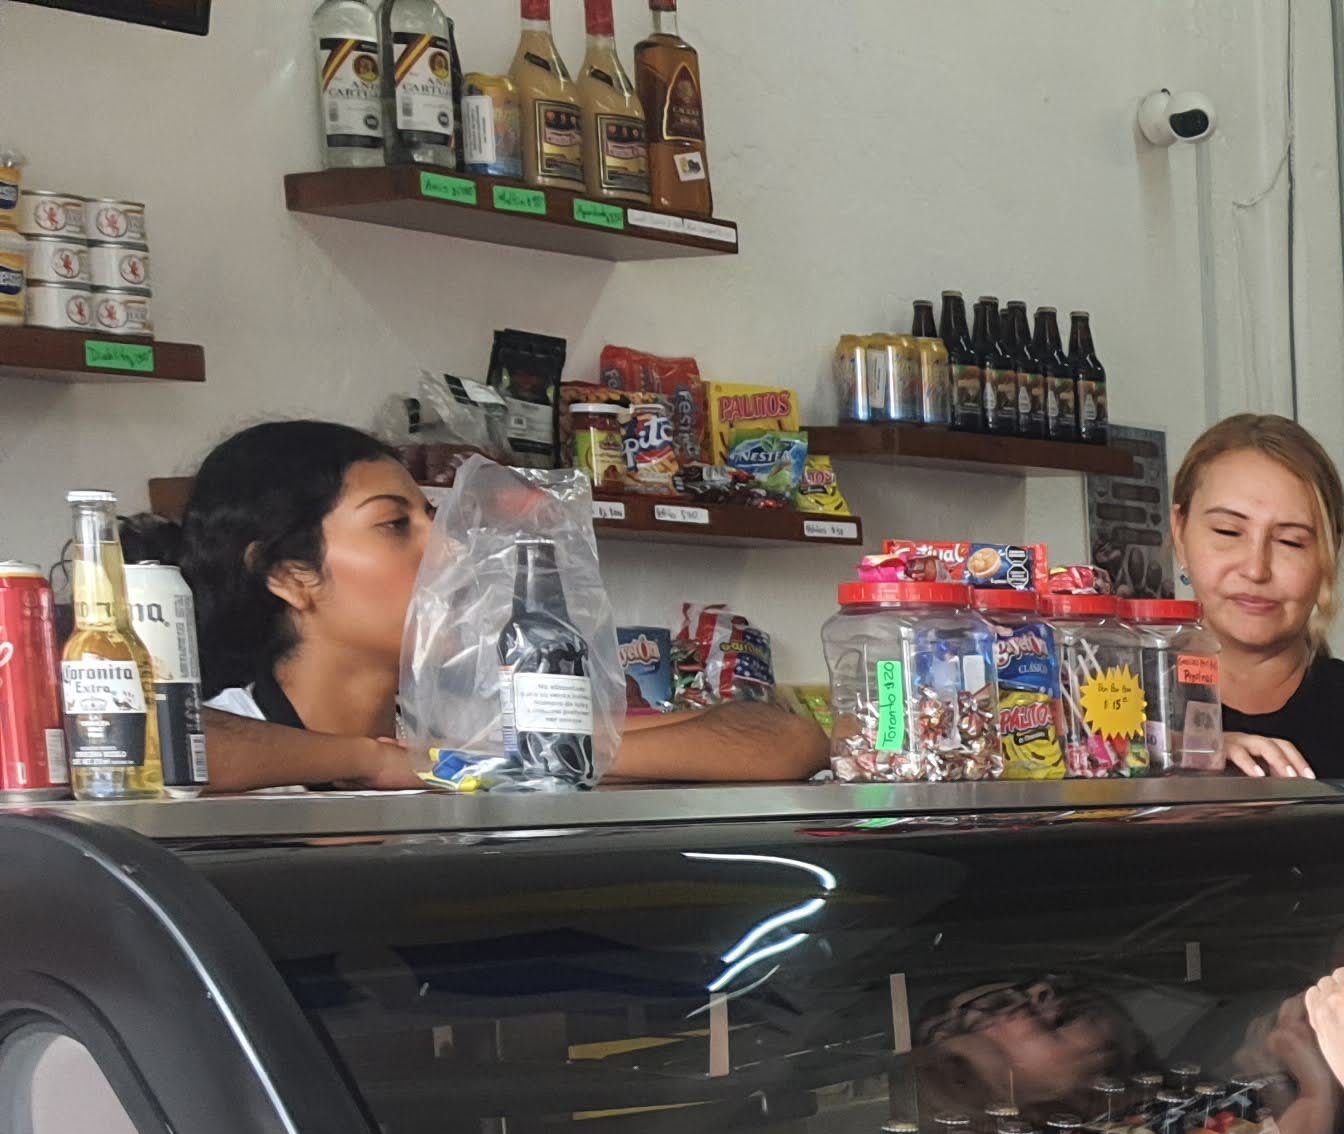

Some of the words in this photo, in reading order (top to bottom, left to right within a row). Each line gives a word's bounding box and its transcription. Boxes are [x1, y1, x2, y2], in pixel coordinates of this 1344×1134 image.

[718, 390, 791, 422] PALITOS
[739, 449, 793, 462] NESTEA
[65, 664, 134, 685] Coronita
[75, 682, 112, 694] Extra
[880, 693, 897, 748] Toronto
